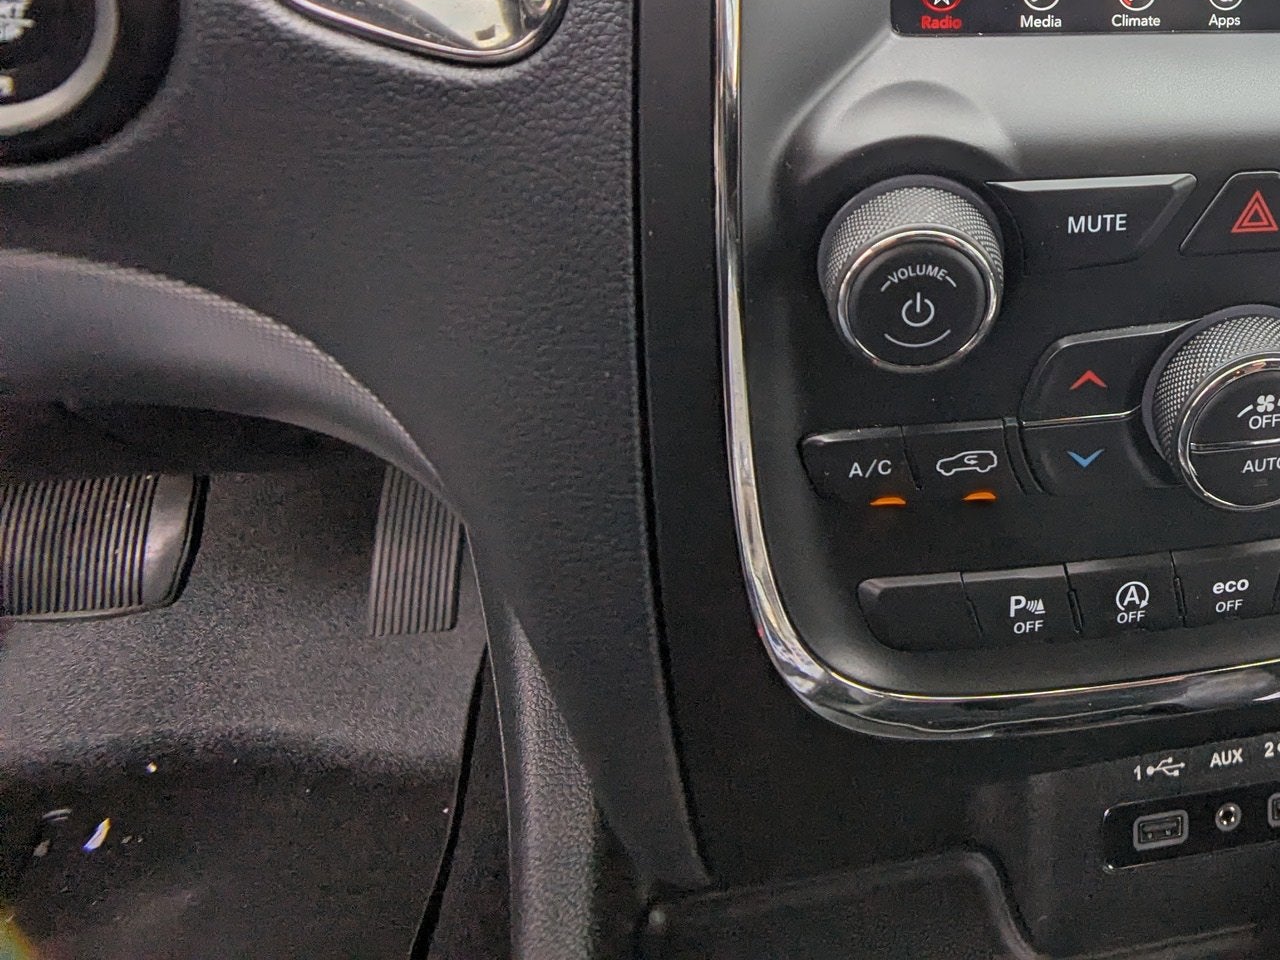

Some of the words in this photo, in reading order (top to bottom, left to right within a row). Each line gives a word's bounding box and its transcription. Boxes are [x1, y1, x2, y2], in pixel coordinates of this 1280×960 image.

[920, 15, 962, 30] Radio
[1020, 14, 1062, 28] Media
[1111, 13, 1161, 27] Climate
[1208, 13, 1241, 29] Apps
[1067, 213, 1127, 234] MUTE
[888, 264, 947, 285] VOLUME
[848, 458, 892, 478] A/C
[1212, 578, 1250, 595] eco
[1215, 598, 1244, 613] OFF
[1116, 610, 1146, 624] OFF
[1013, 619, 1044, 634] OFF
[1209, 747, 1244, 768] AUX
[1264, 741, 1275, 758] 2
